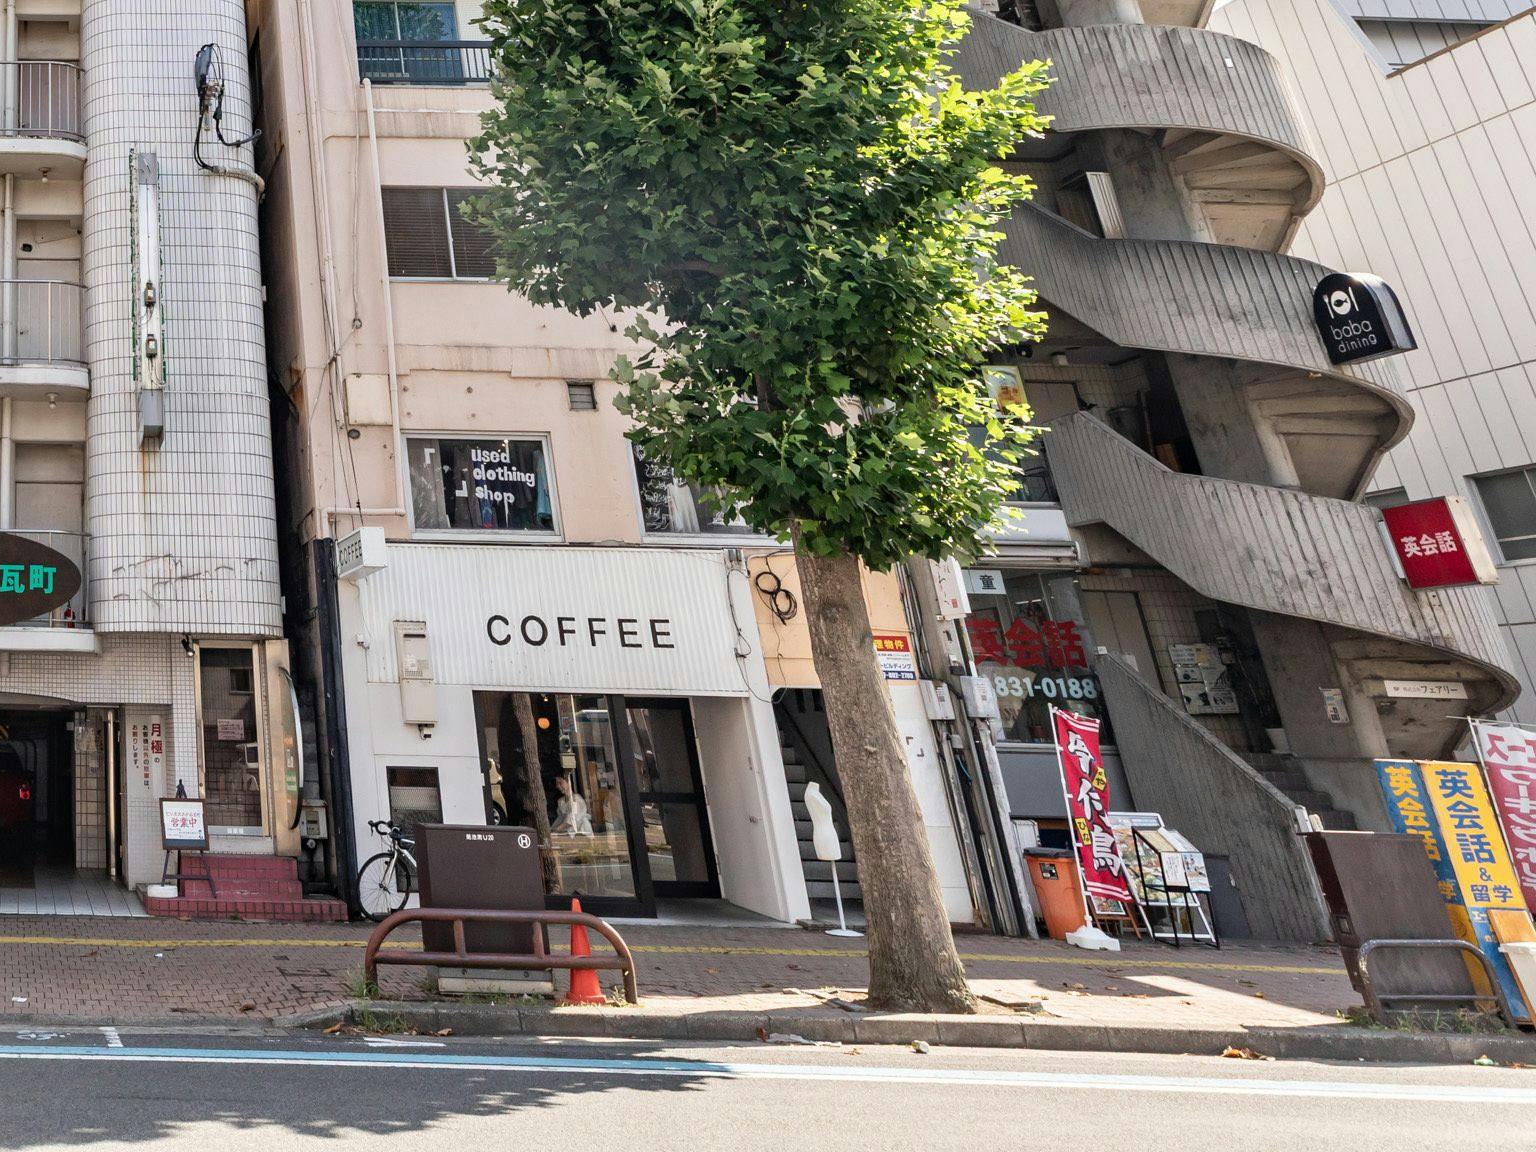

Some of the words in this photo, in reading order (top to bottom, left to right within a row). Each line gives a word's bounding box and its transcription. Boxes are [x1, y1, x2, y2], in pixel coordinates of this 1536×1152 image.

[1330, 320, 1373, 340] baba
[1338, 334, 1378, 353] dining
[471, 443, 511, 464] used
[472, 464, 536, 487] clothing
[475, 485, 516, 505] shop
[338, 539, 363, 567] COFFEE
[1400, 530, 1458, 558] 英会話
[486, 614, 675, 650] COFFEE
[966, 618, 1089, 669] 英会話
[170, 817, 197, 828] 営業中
[1435, 768, 1496, 865] 英会話
[1479, 866, 1493, 882] &
[1470, 883, 1514, 903] 留学
